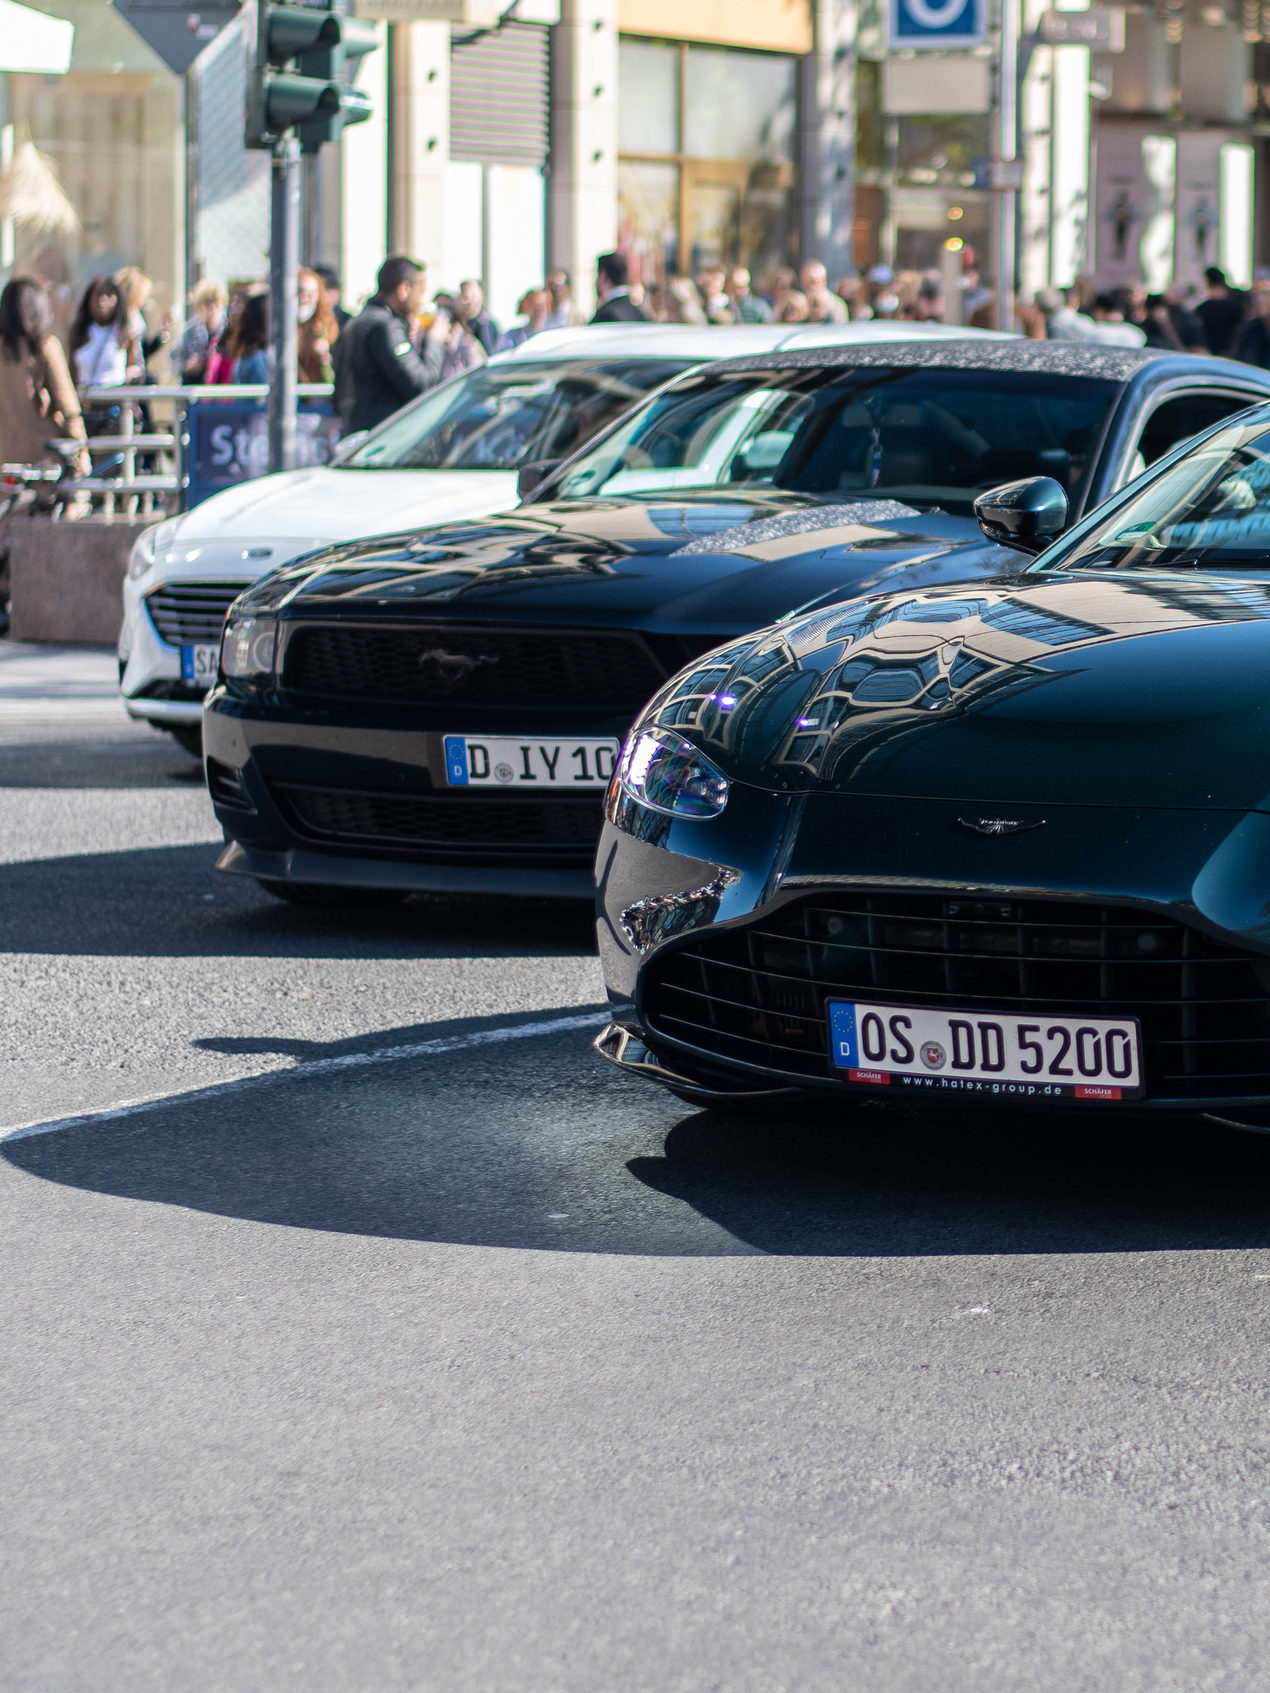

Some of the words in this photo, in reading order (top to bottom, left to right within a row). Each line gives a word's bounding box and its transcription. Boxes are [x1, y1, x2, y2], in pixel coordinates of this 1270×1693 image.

[468, 744, 490, 779] D
[520, 746, 561, 780] IY
[840, 1042, 850, 1056] D
[861, 1012, 914, 1064] OS
[948, 1019, 1005, 1072] DD
[1018, 1024, 1132, 1079] 5200
[903, 1076, 1062, 1095] www.hatex-group.de
